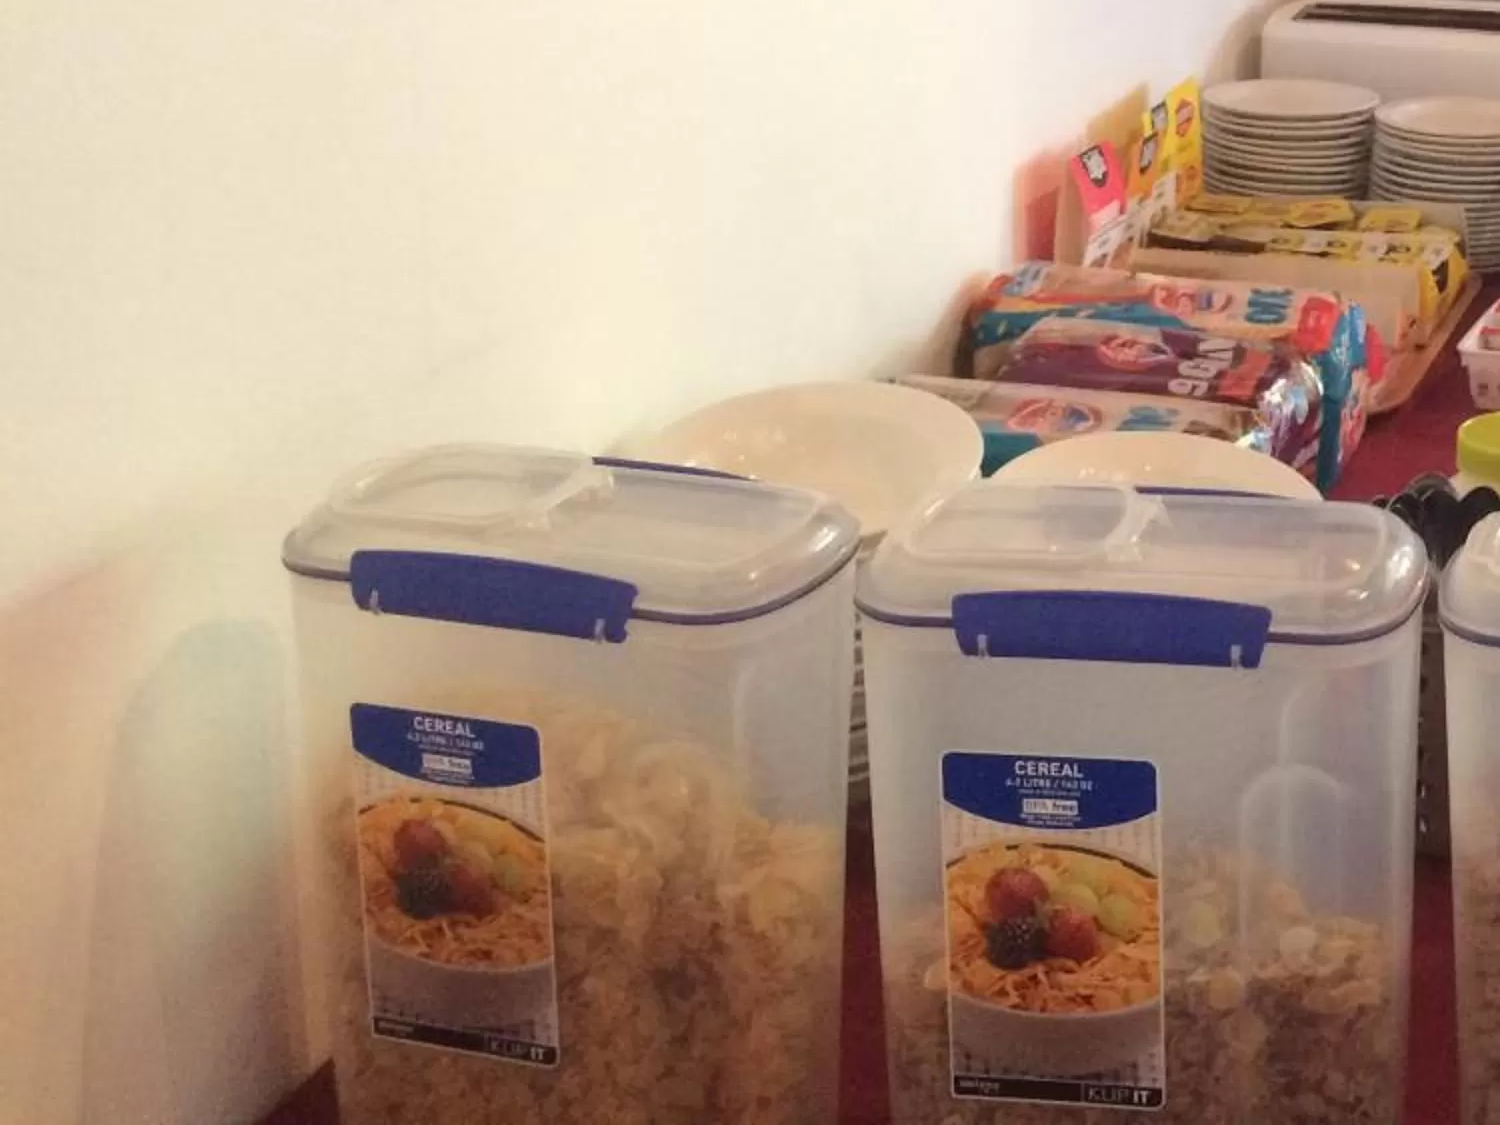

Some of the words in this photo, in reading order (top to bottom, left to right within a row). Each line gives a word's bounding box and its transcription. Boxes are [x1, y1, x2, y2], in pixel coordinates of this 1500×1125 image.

[413, 715, 477, 739] CEREAL
[1014, 760, 1085, 779] CEREAL
[1132, 1089, 1153, 1105] IT
